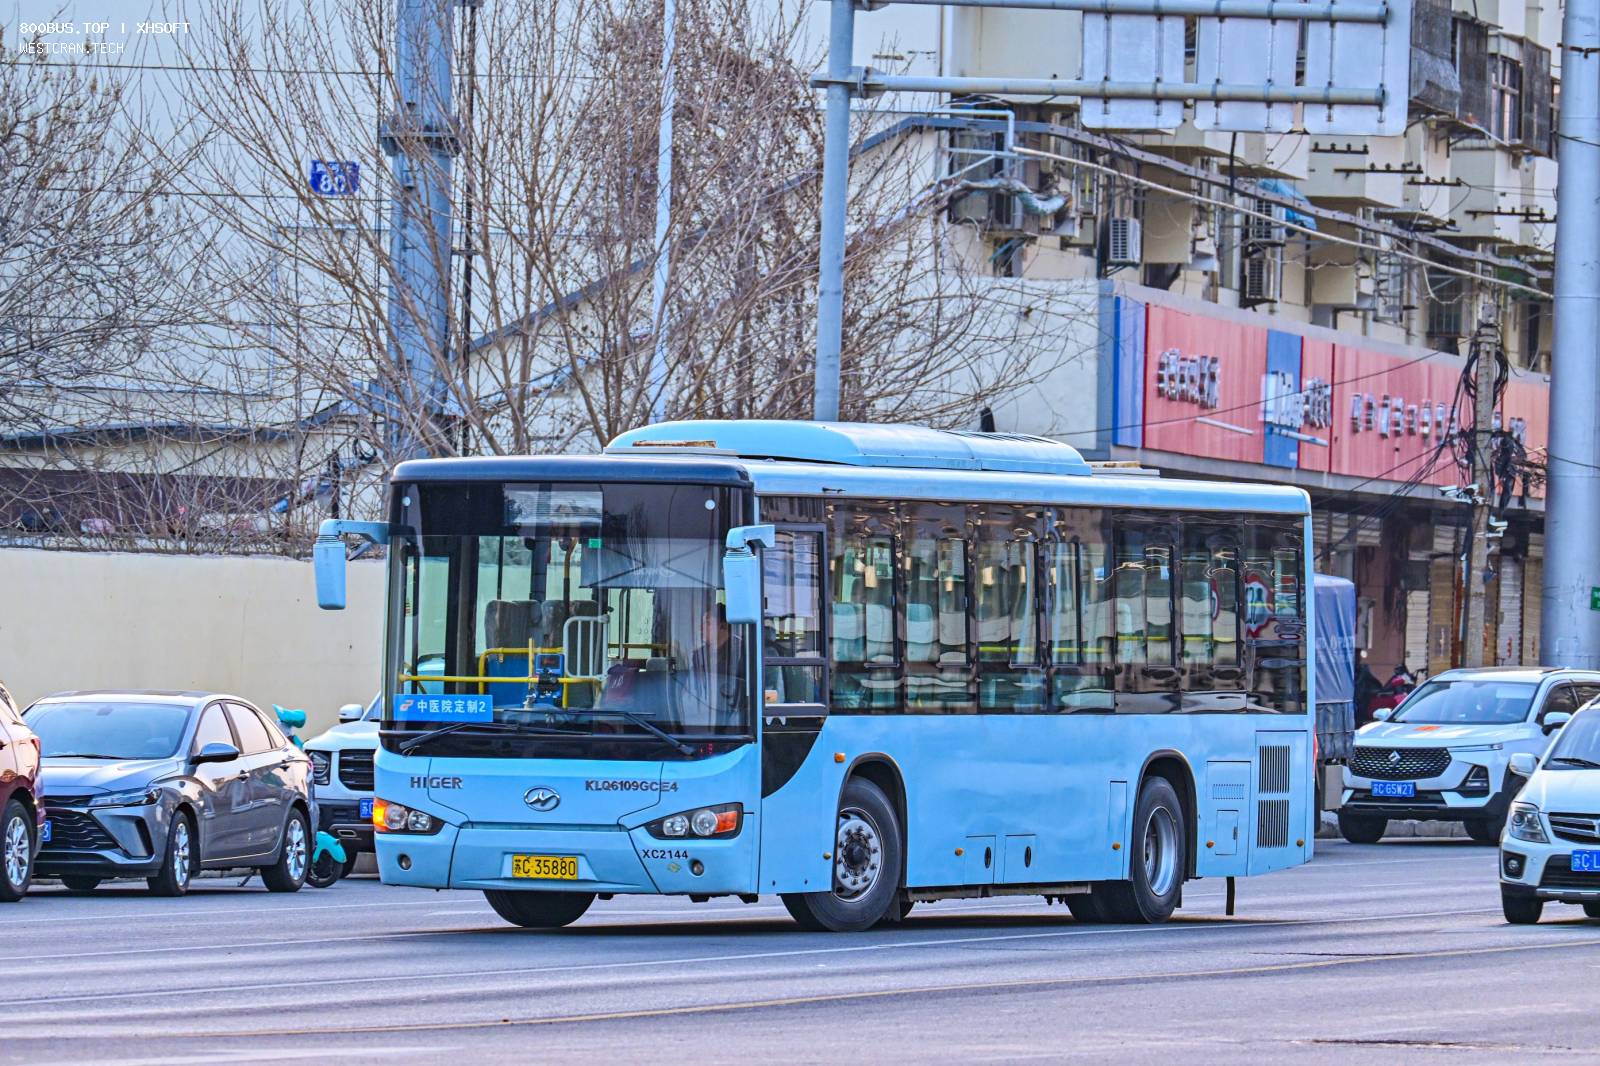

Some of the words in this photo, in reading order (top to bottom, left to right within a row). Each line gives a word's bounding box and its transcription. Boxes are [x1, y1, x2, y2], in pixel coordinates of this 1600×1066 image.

[417, 699, 486, 714] 中医院定制2
[410, 776, 463, 790] HIGER
[585, 779, 679, 792] KLQ6109GCE4
[642, 849, 689, 860] XC2144
